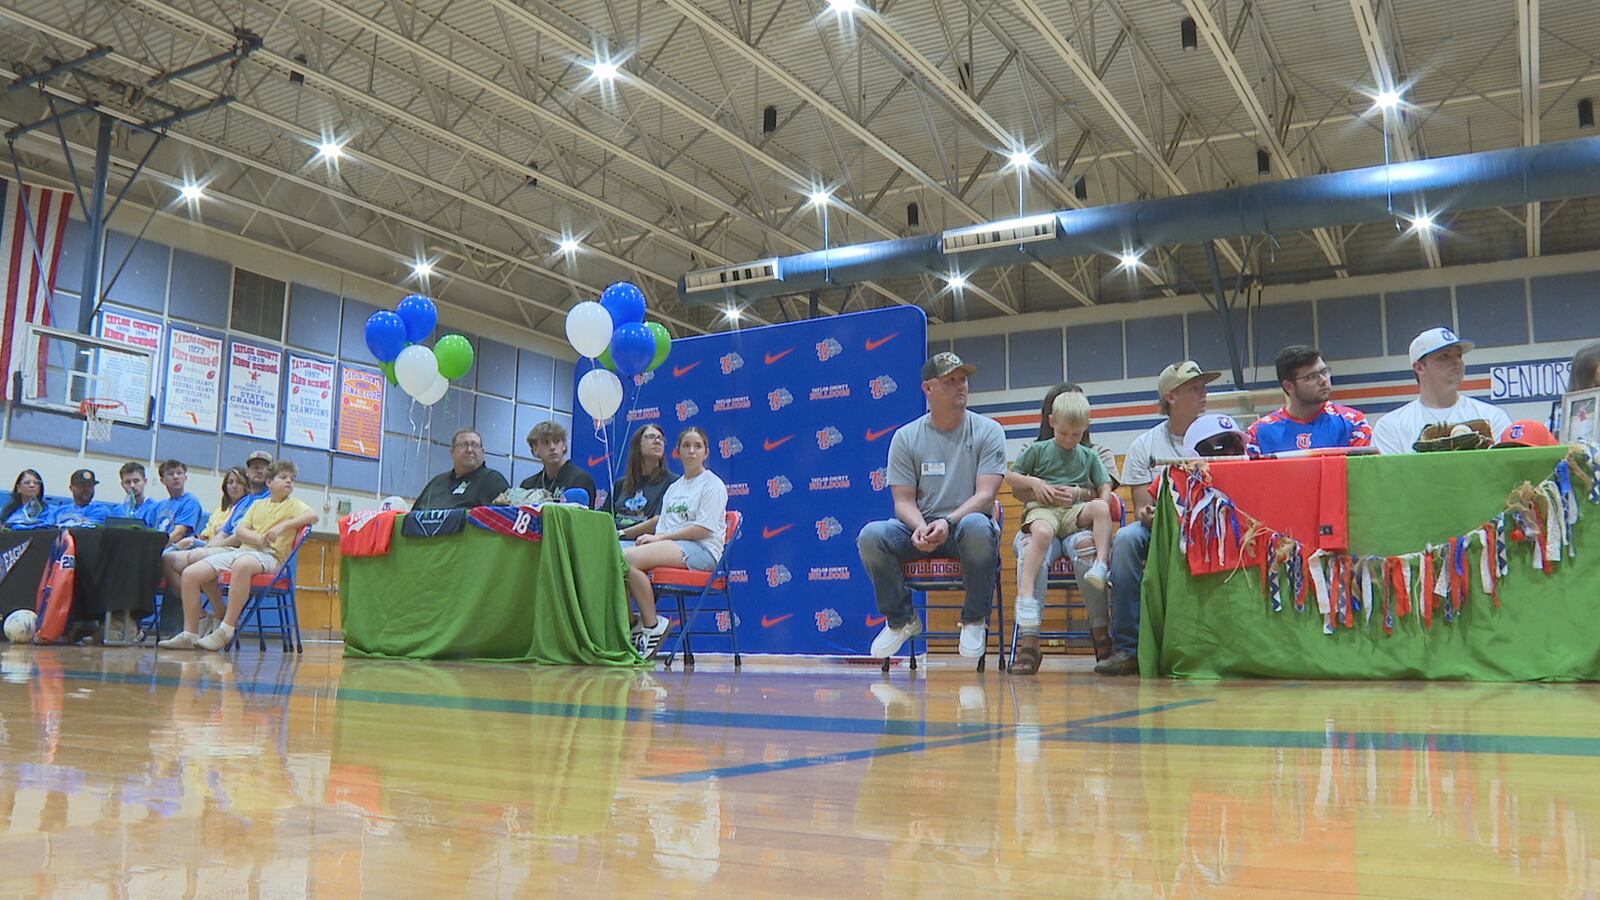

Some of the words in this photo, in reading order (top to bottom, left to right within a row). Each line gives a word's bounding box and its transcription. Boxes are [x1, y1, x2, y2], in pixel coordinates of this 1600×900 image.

[174, 332, 196, 344] TAYLOR
[196, 338, 220, 353] COUNTY
[188, 345, 205, 354] 1977
[234, 344, 255, 355] TAYLOR
[256, 349, 279, 362] COUNTY
[247, 355, 265, 364] 2019
[232, 355, 250, 369] HIGH
[252, 362, 278, 374] SCHOOL
[292, 359, 311, 370] TAYLOR
[312, 363, 332, 377] COUNTY
[291, 372, 306, 385] HIGH
[307, 379, 331, 390] SCHOOL
[304, 370, 321, 379] 1997
[230, 395, 275, 409] CHAMPION
[240, 391, 265, 401] STATE
[300, 397, 320, 408] STATE
[290, 404, 329, 417] CHAMPIONS
[512, 509, 531, 535] 18
[3, 541, 29, 572] EAGL
